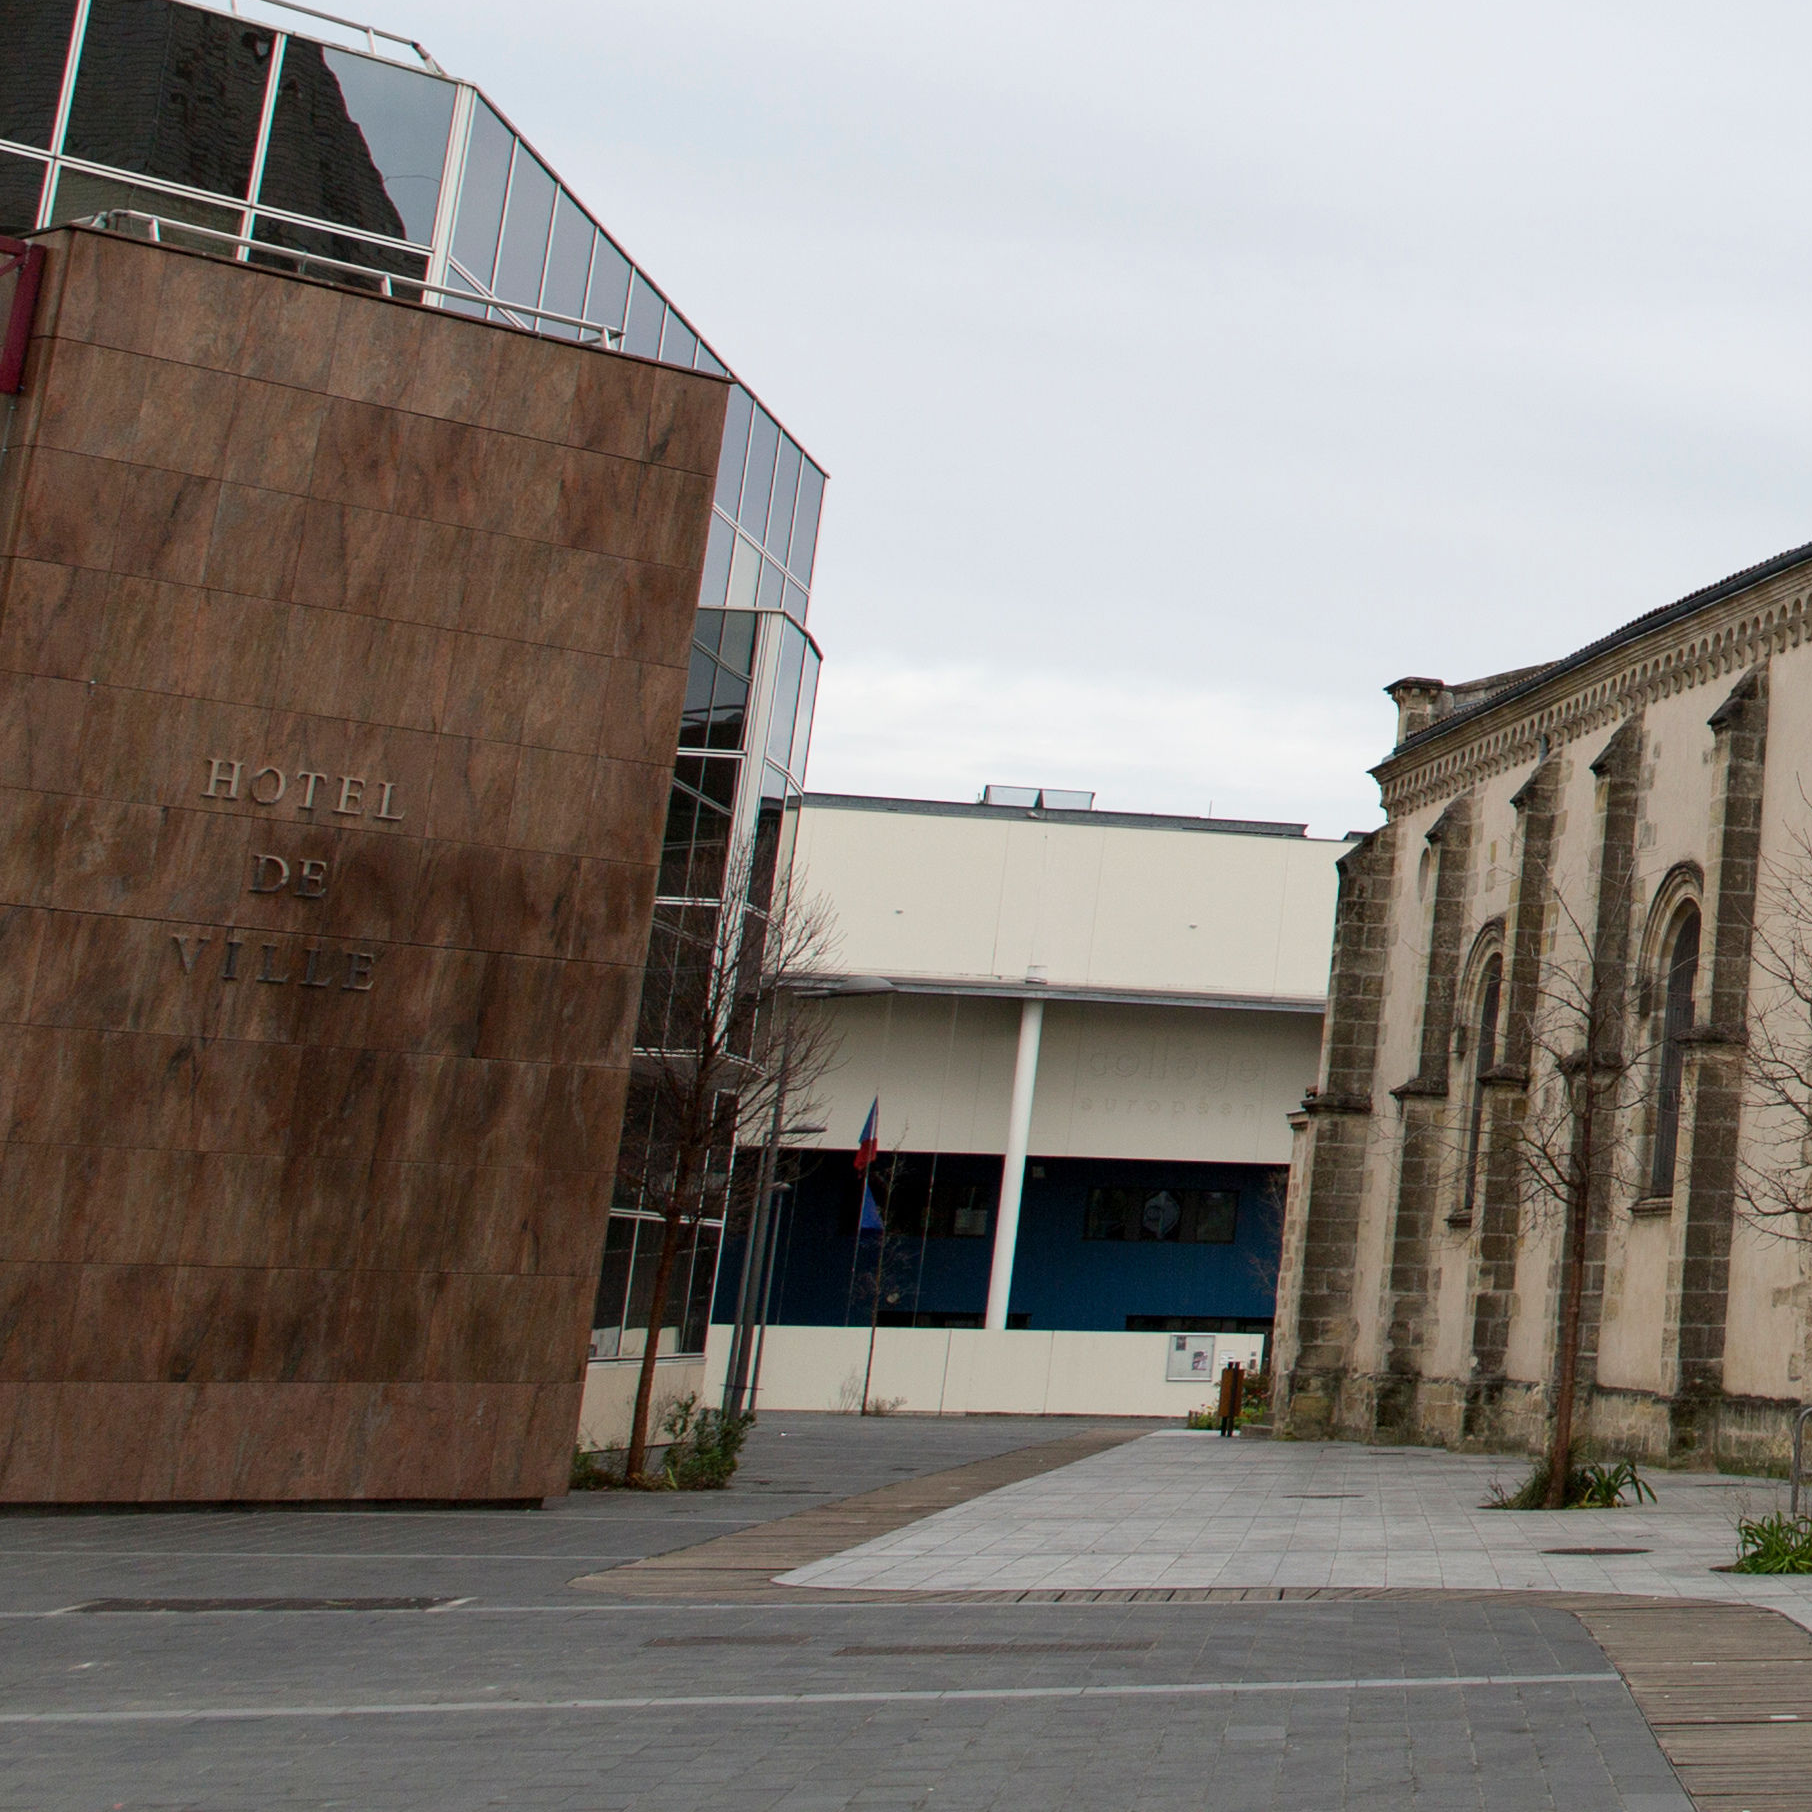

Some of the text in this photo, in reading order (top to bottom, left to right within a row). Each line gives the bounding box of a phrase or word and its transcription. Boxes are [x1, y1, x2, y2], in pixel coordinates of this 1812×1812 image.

[201, 758, 406, 821] HOTEL
[249, 854, 327, 898] DE
[173, 933, 375, 990] VILLE
